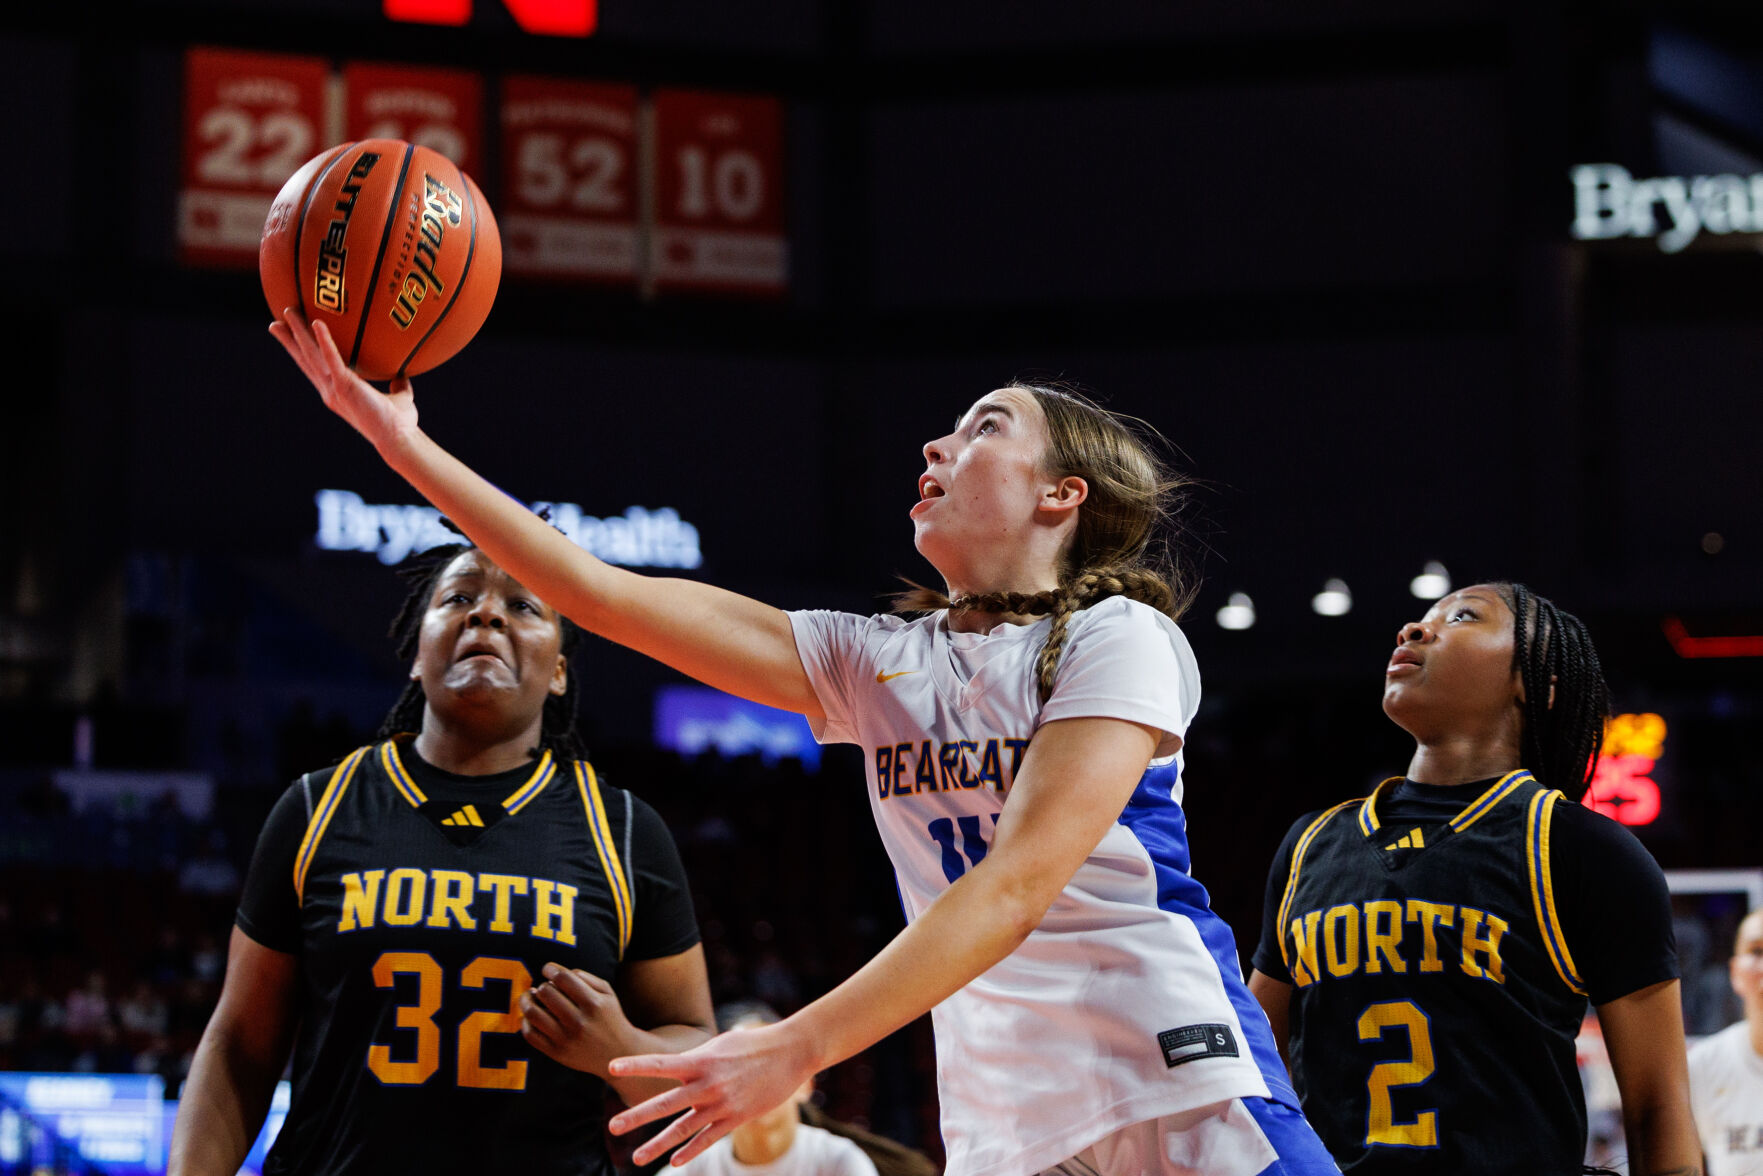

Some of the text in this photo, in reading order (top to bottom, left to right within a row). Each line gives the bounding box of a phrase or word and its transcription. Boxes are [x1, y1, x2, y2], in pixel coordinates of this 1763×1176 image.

[200, 104, 312, 186] 22
[517, 133, 622, 210] 52
[680, 147, 763, 221] 10
[318, 152, 382, 311] ELITE PRO
[389, 171, 464, 330] Baden
[316, 489, 472, 566] Brya
[337, 868, 579, 947] NORTH
[1290, 899, 1511, 989] NORTH
[366, 950, 535, 1093] 32
[1215, 1033, 1226, 1046] S
[1357, 999, 1440, 1148] 2
